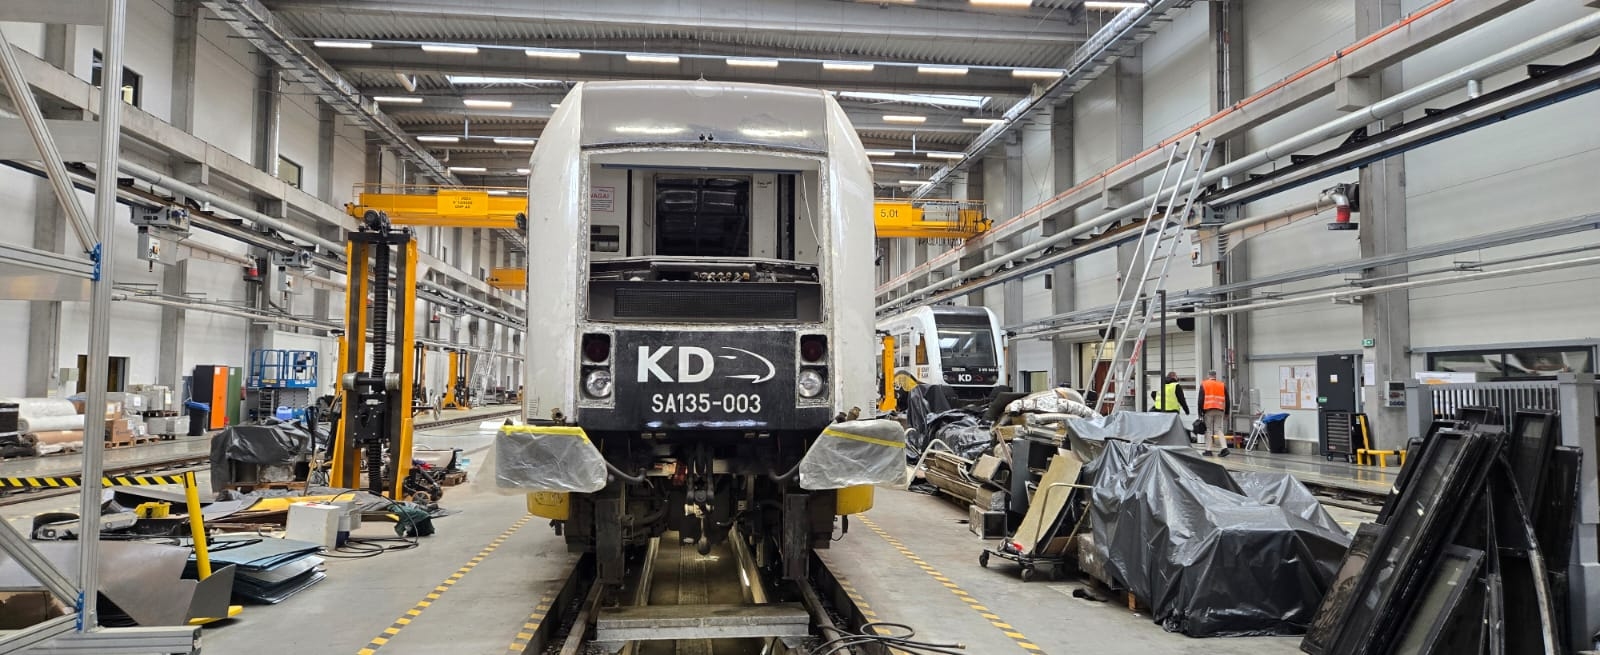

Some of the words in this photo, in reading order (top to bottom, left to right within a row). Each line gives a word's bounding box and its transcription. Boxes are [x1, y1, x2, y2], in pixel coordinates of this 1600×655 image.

[880, 208, 898, 219] 5,0t
[637, 345, 715, 383] KD
[958, 374, 972, 382] KD
[651, 393, 761, 413] SA135-003
